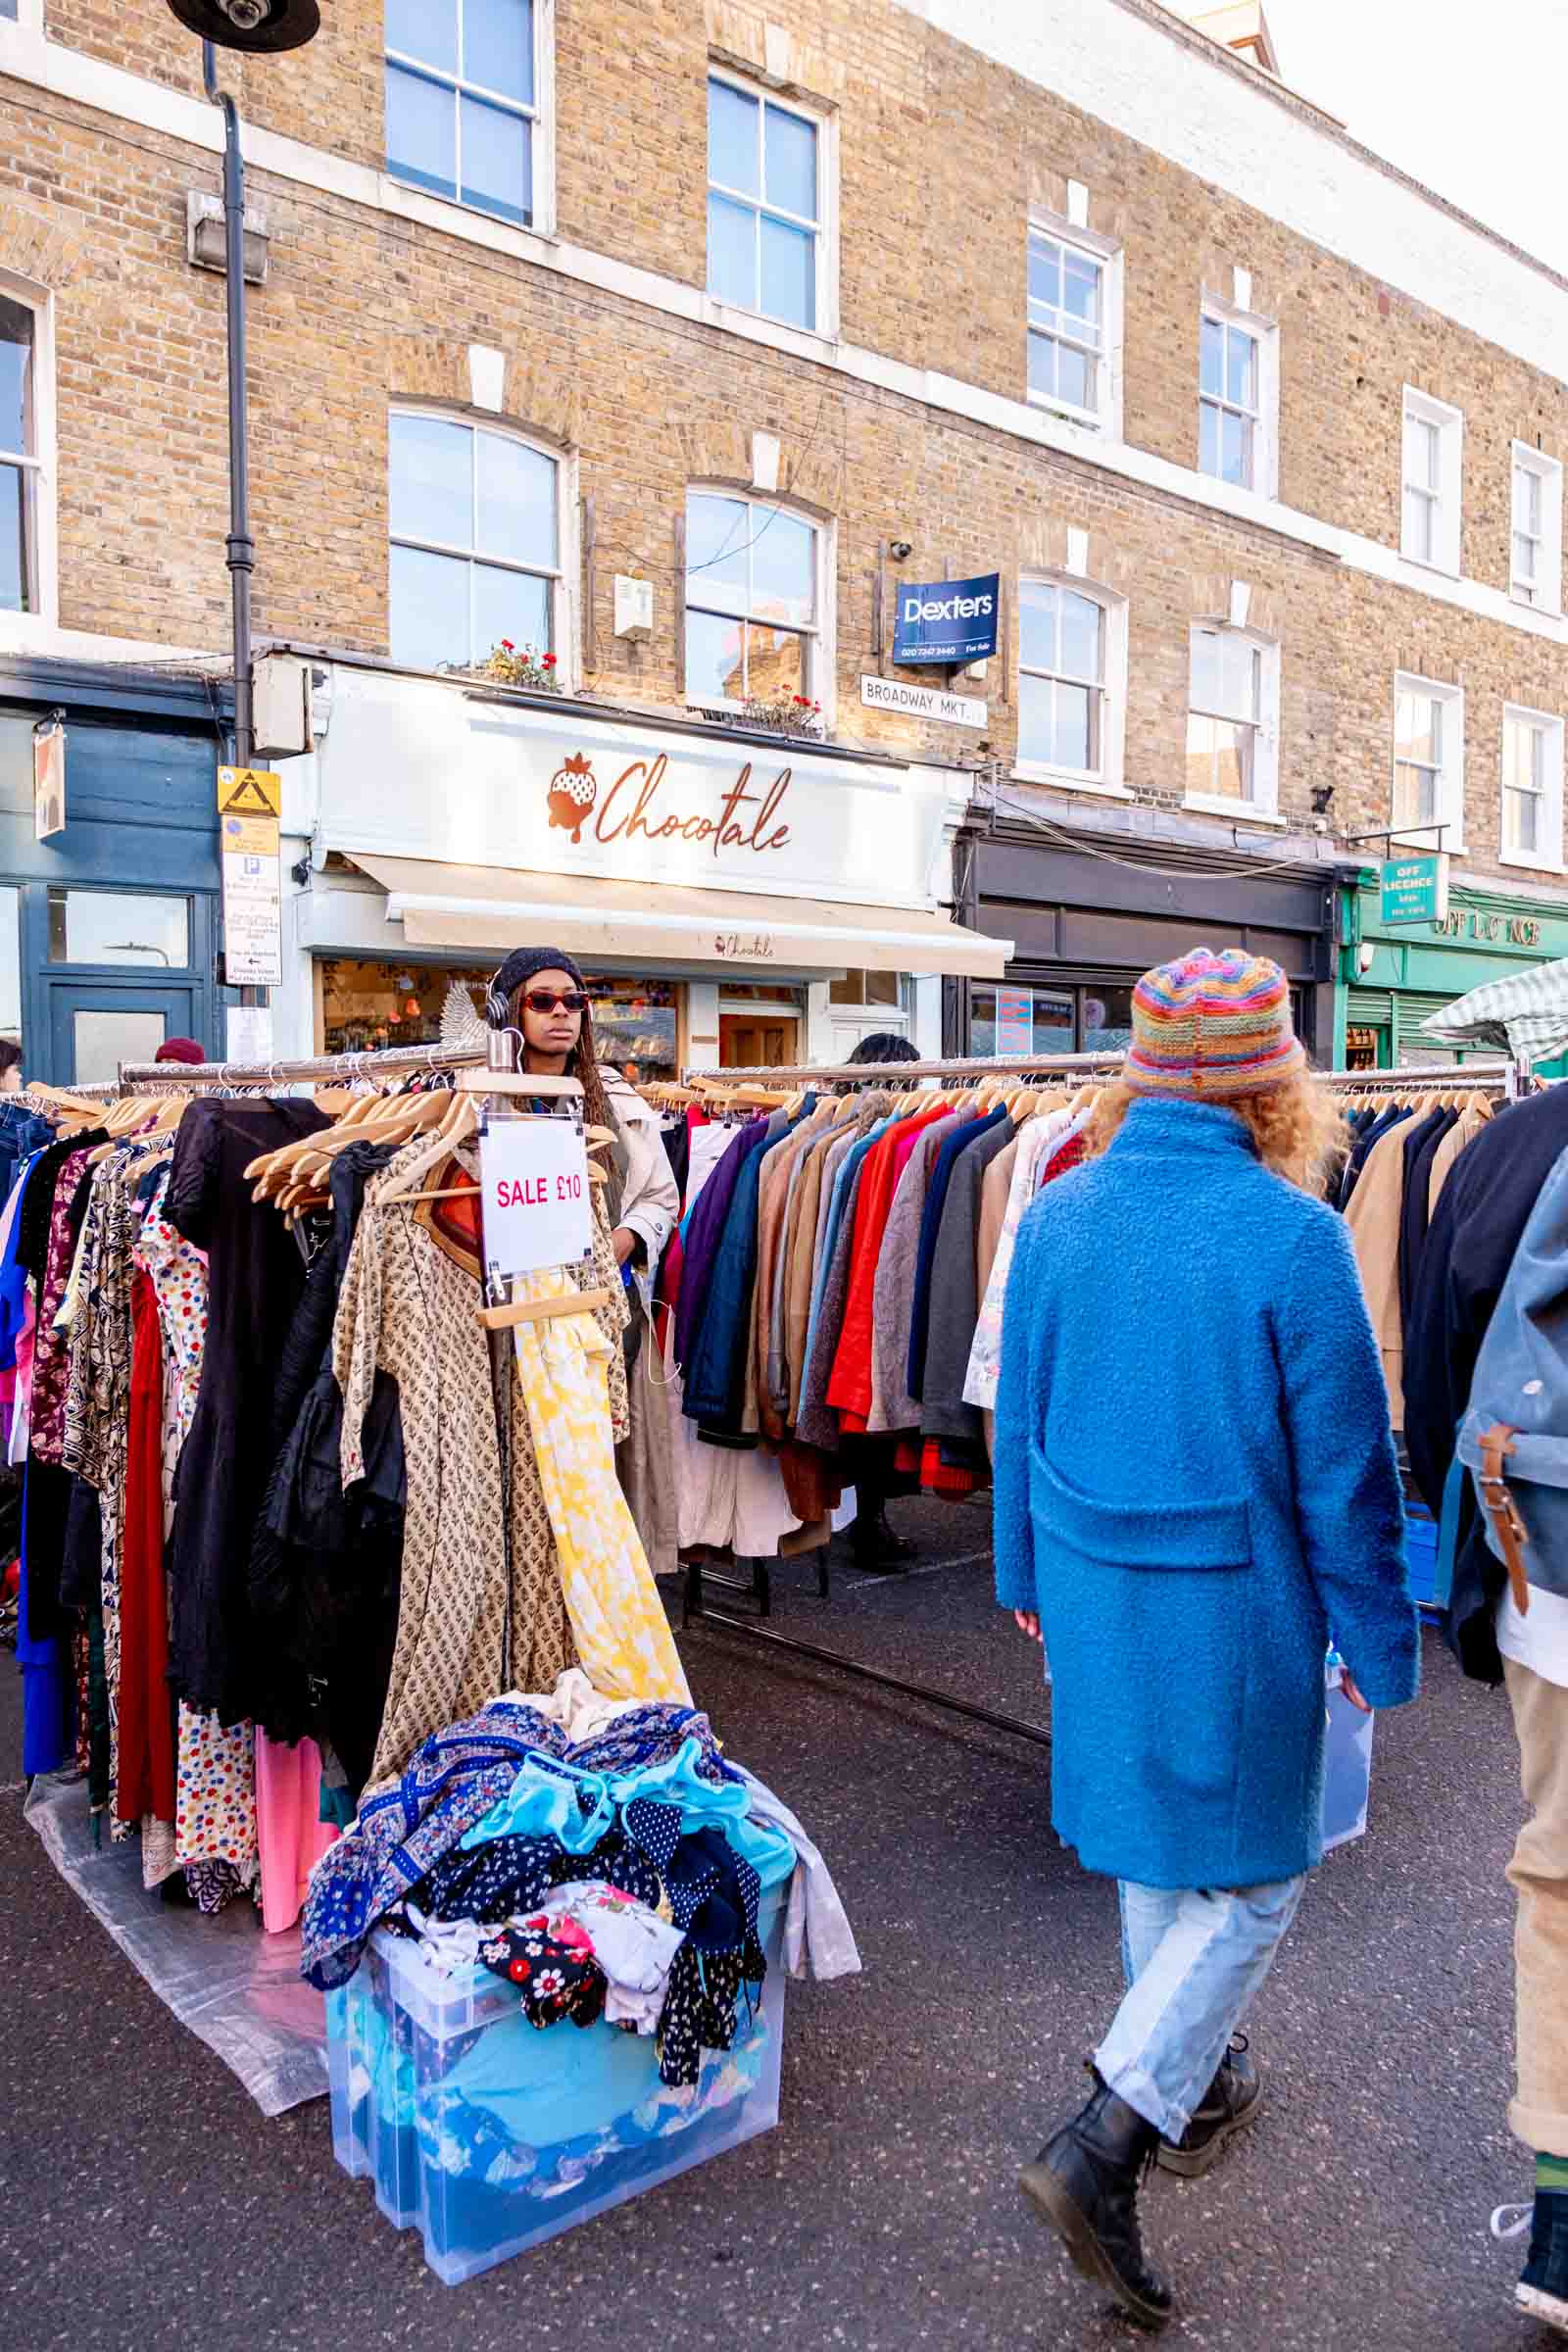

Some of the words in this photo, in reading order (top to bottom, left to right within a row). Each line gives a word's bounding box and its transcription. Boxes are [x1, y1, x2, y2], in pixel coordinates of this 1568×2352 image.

[904, 595, 993, 624] Dexters
[867, 682, 933, 710] BROADWAY
[596, 753, 792, 858] Chocotale
[1384, 877, 1435, 892] LICENCE
[1396, 865, 1420, 877] OFF
[1473, 908, 1540, 947] LCNCE
[497, 1177, 548, 1208] SALE
[557, 1175, 581, 1200] £10
